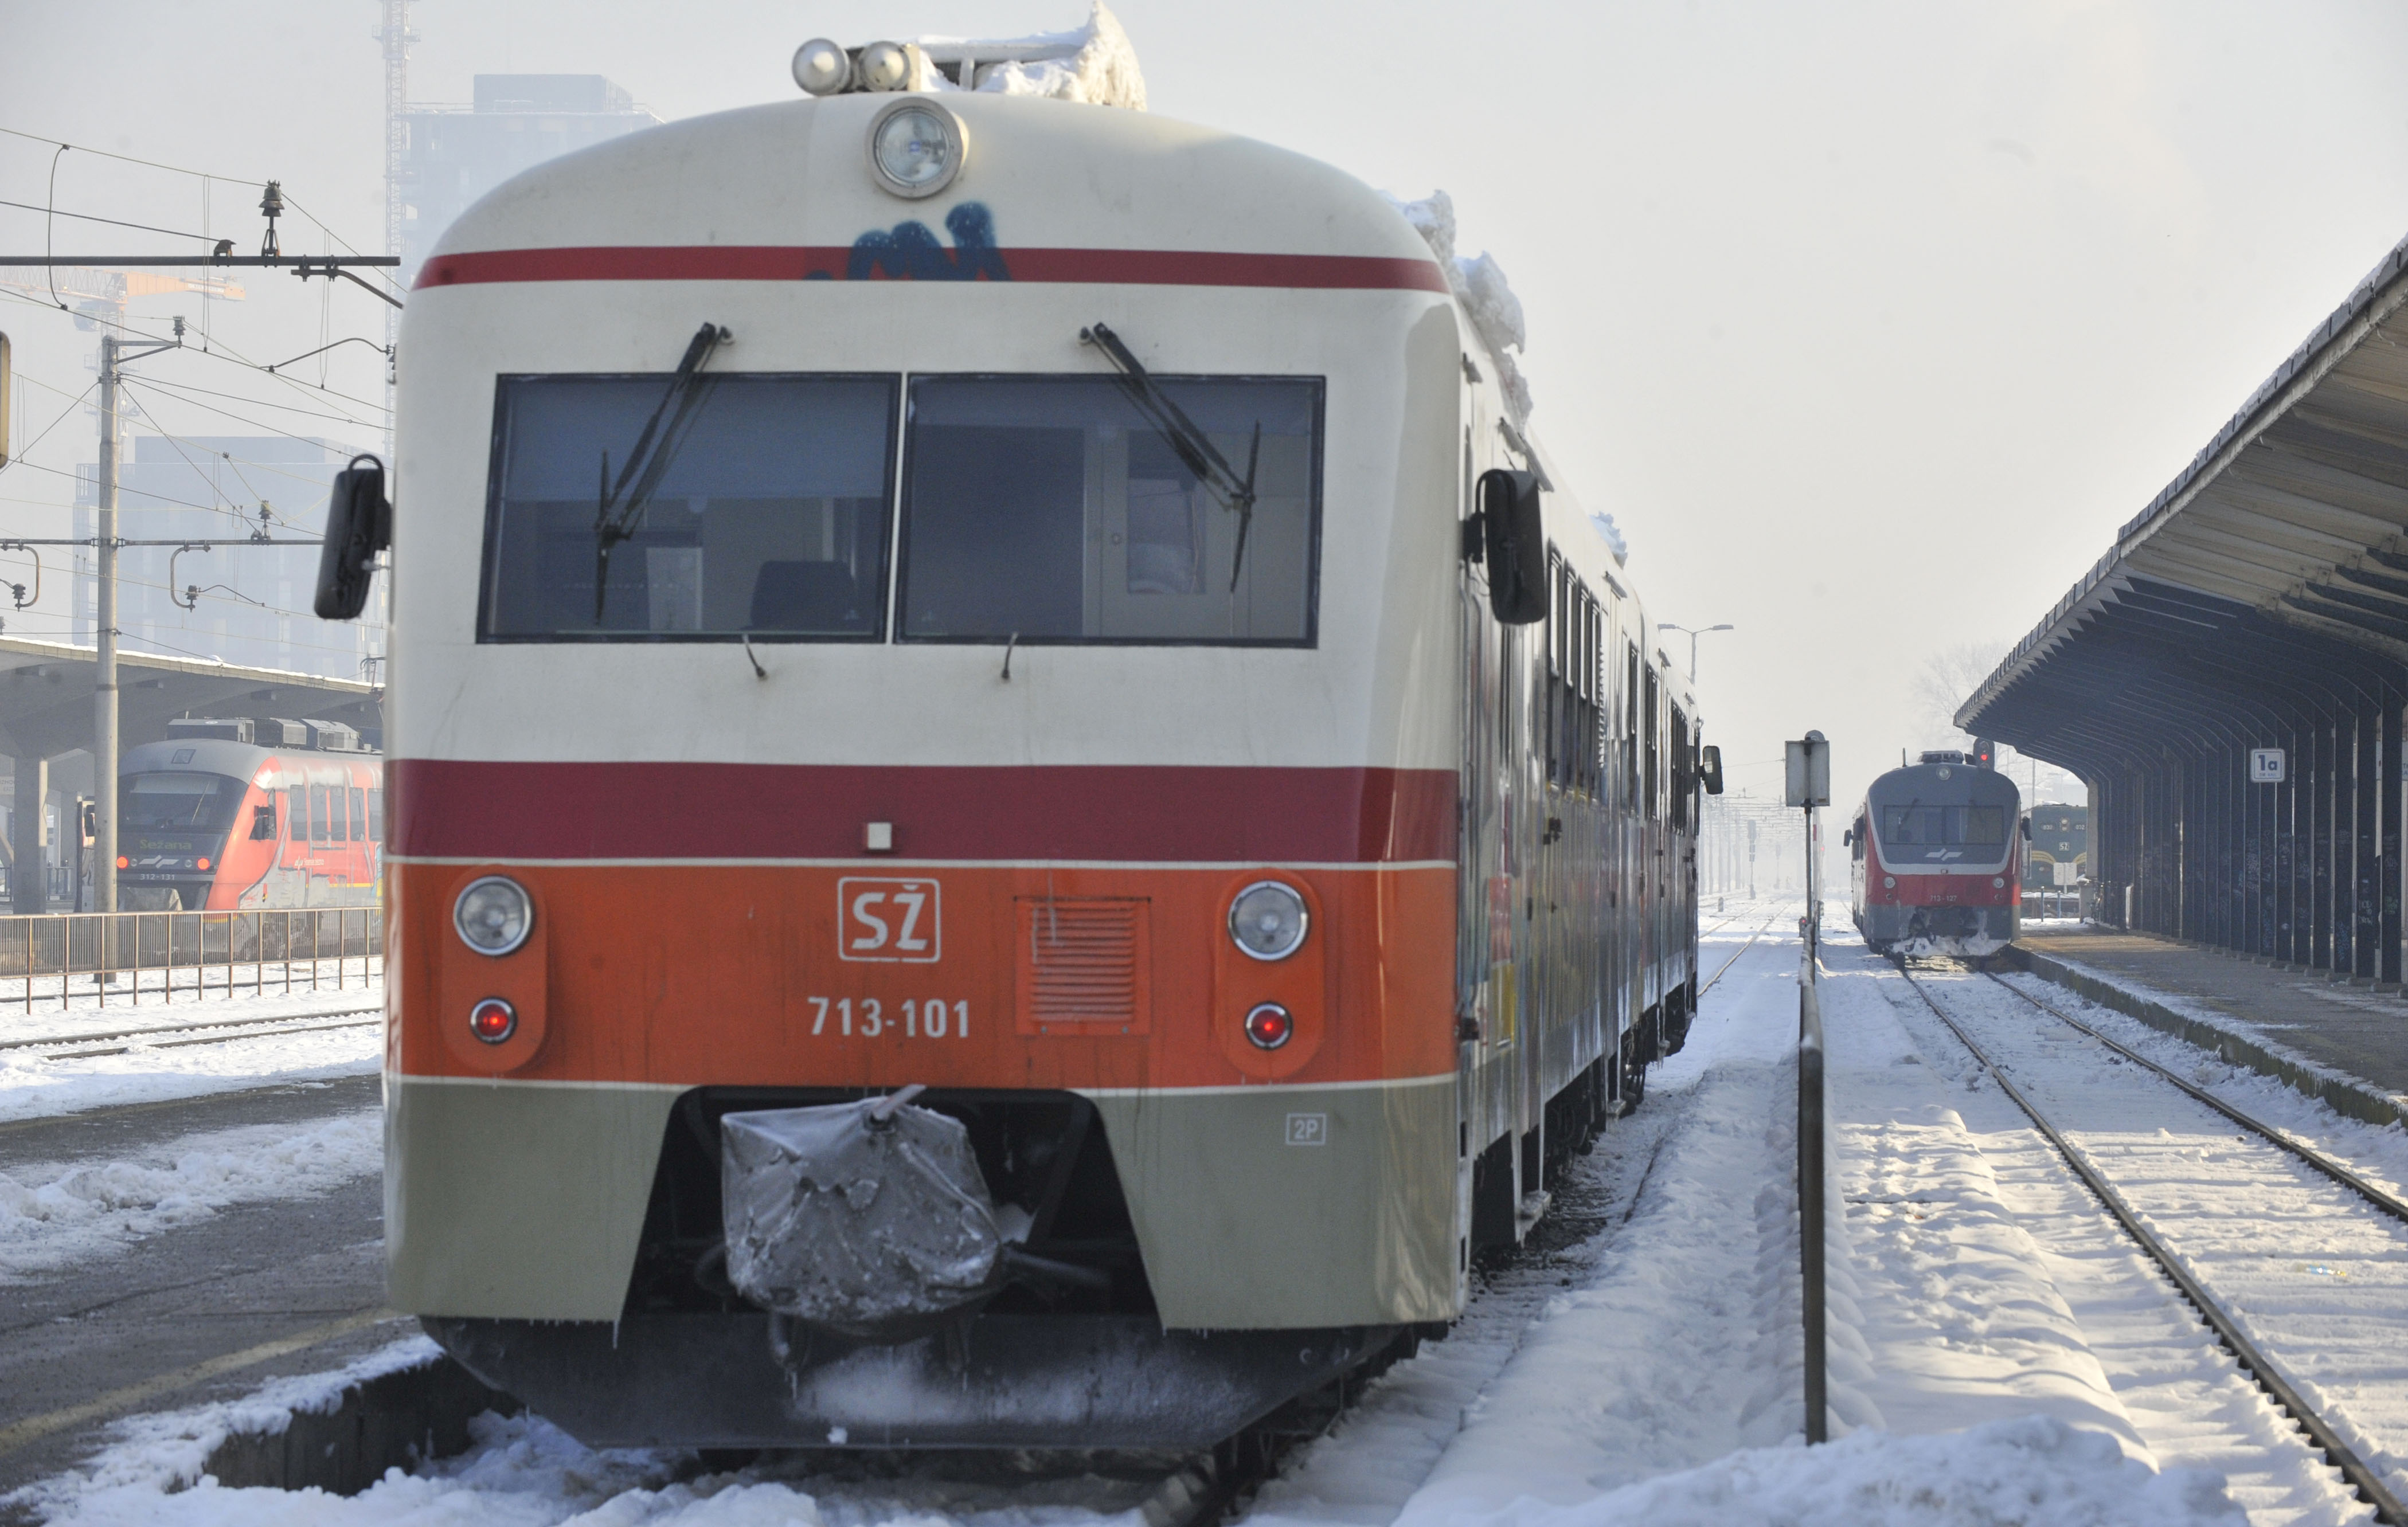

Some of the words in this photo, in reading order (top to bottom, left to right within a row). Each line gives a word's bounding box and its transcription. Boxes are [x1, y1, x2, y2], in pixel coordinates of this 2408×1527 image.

[2258, 754, 2277, 771] 1a
[140, 839, 192, 850] Sežana
[851, 884, 928, 950] SŽ
[807, 996, 968, 1038] 713-101
[1294, 1119, 1318, 1139] 2P
